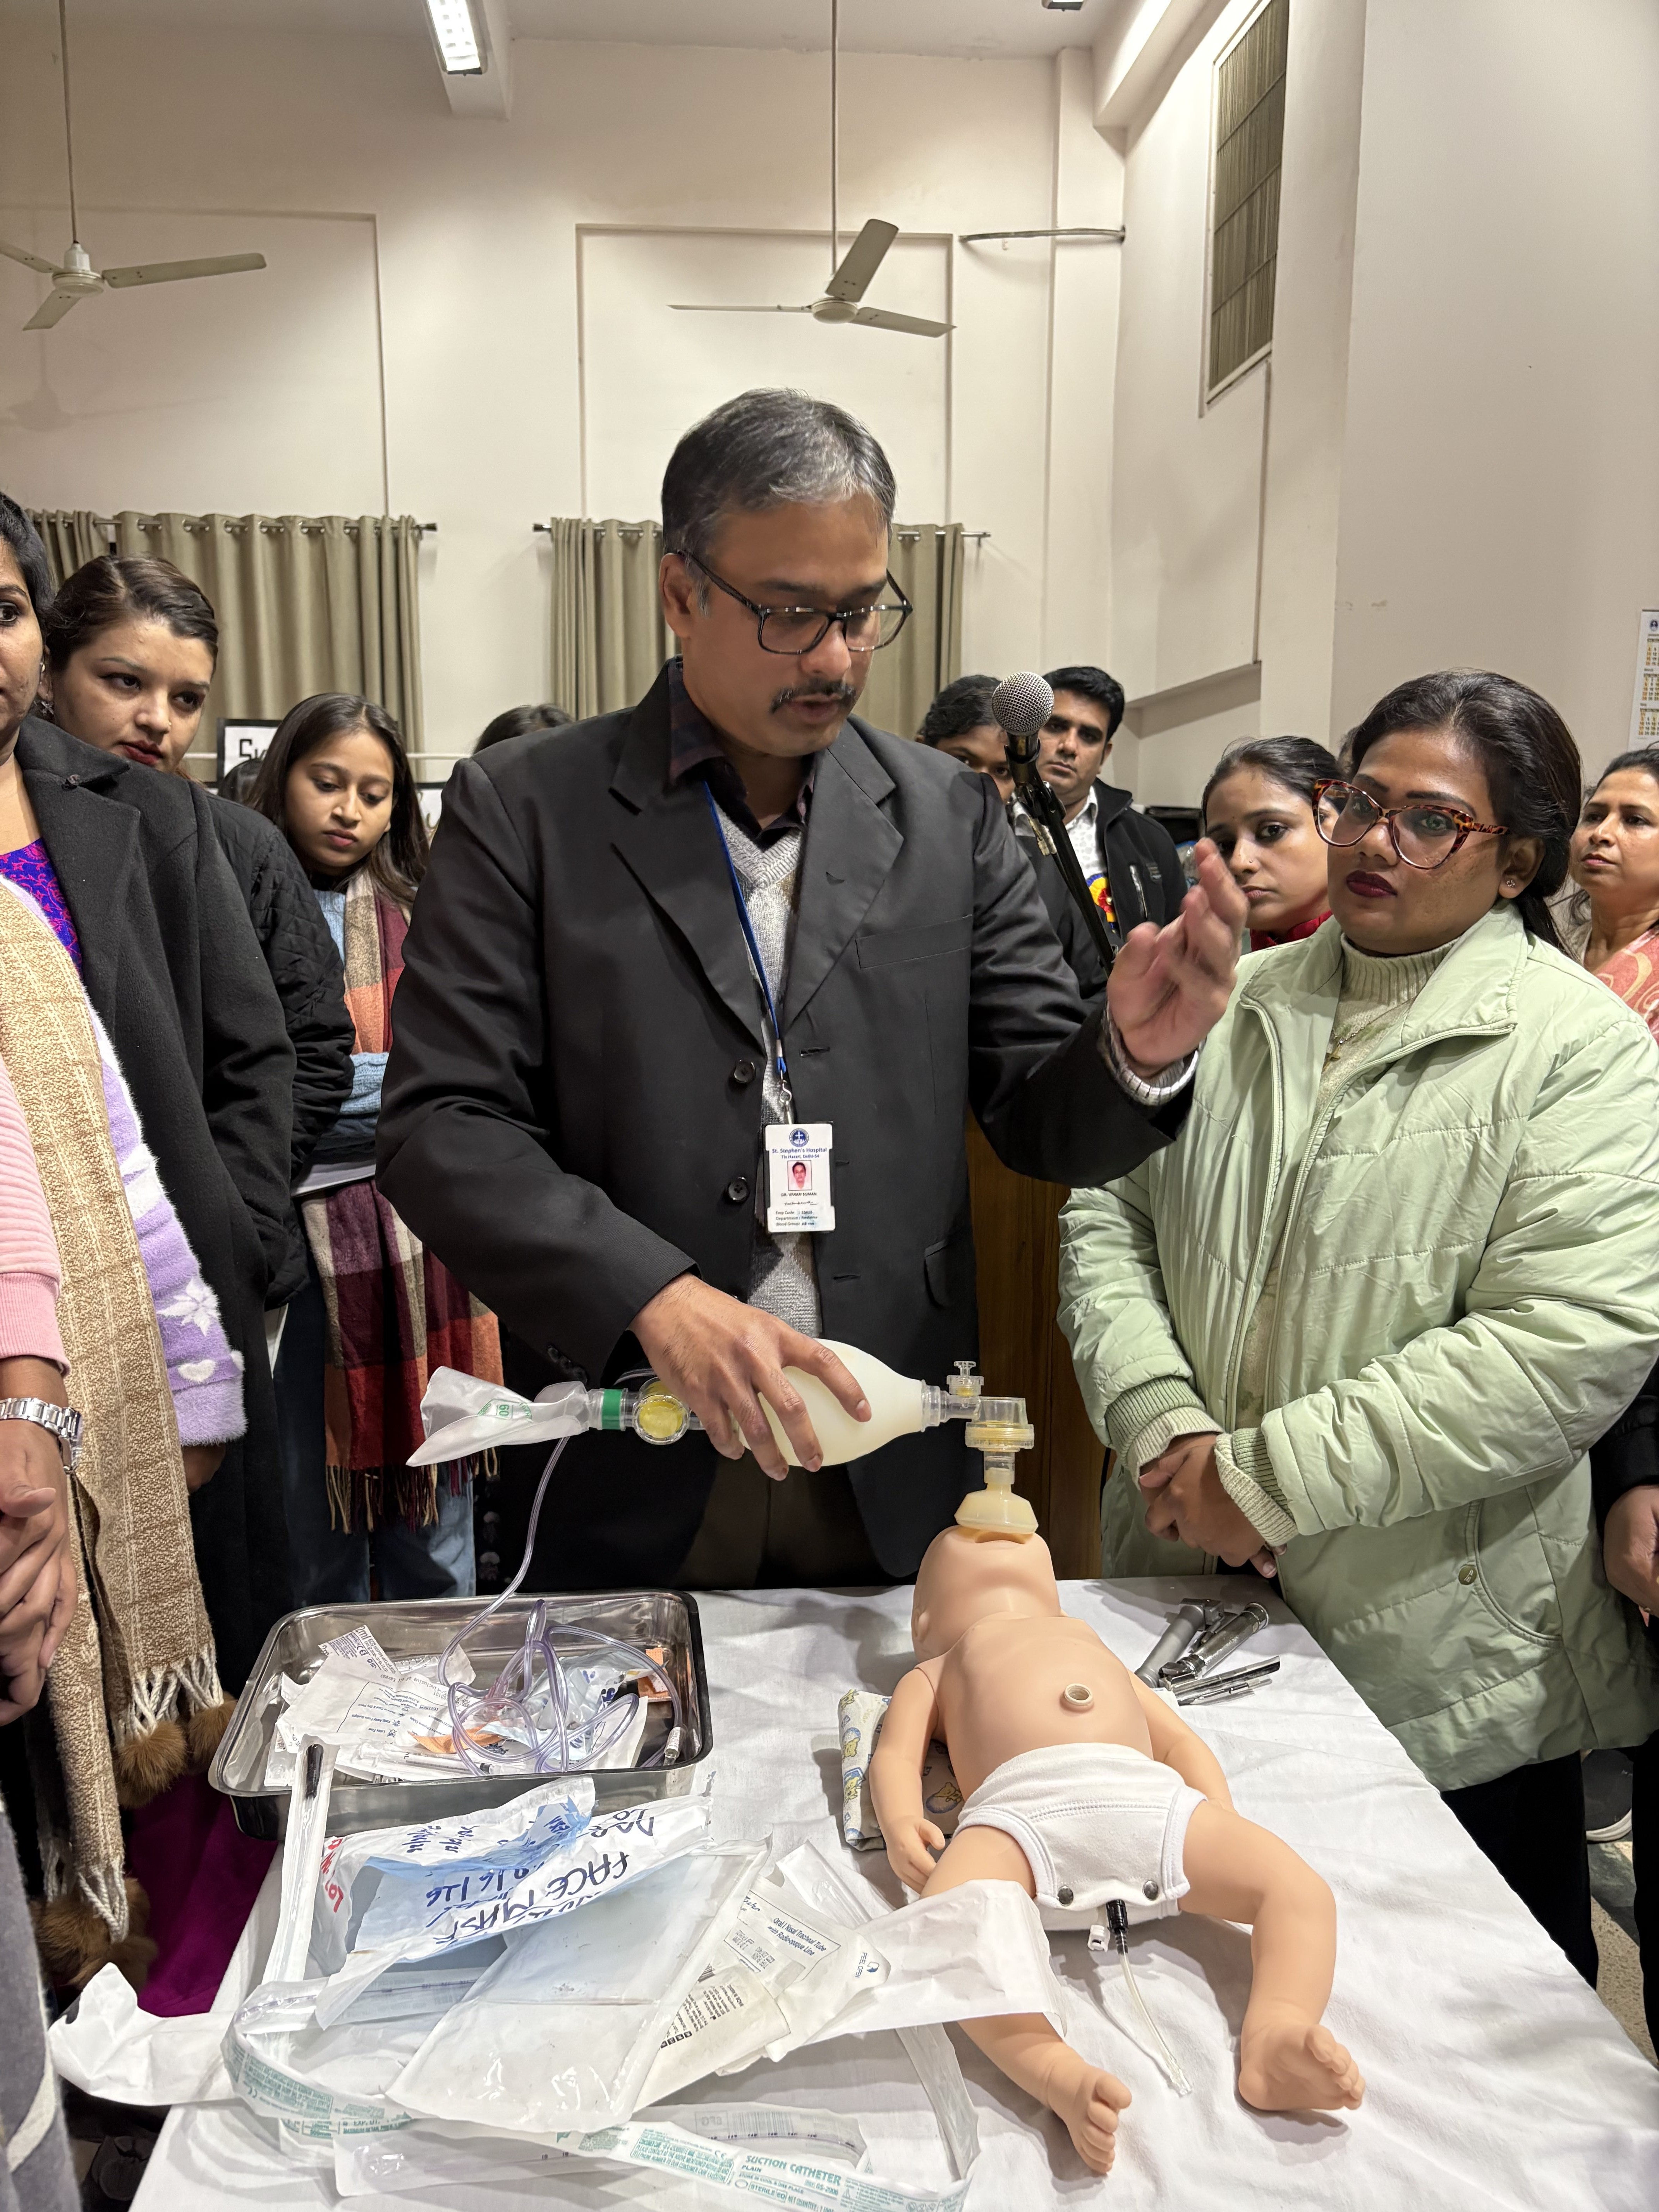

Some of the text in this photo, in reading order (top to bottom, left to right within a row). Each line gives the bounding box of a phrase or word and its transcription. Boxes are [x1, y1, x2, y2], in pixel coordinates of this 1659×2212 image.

[356, 1626, 371, 1642] 2ml
[545, 1851, 629, 1900] FACE
[768, 1926, 778, 1935] with
[803, 1945, 815, 1956] Line
[773, 1918, 783, 1926] Oral
[785, 1924, 795, 1935] Nasal
[796, 1930, 814, 1944] Tracheal
[813, 1941, 826, 1951] Tube
[859, 1952, 867, 1965] PEEL
[741, 2165, 762, 2173] PLAIN
[746, 2155, 842, 2186] SUCTION CATHETER
[751, 2183, 775, 2196] STERILE
